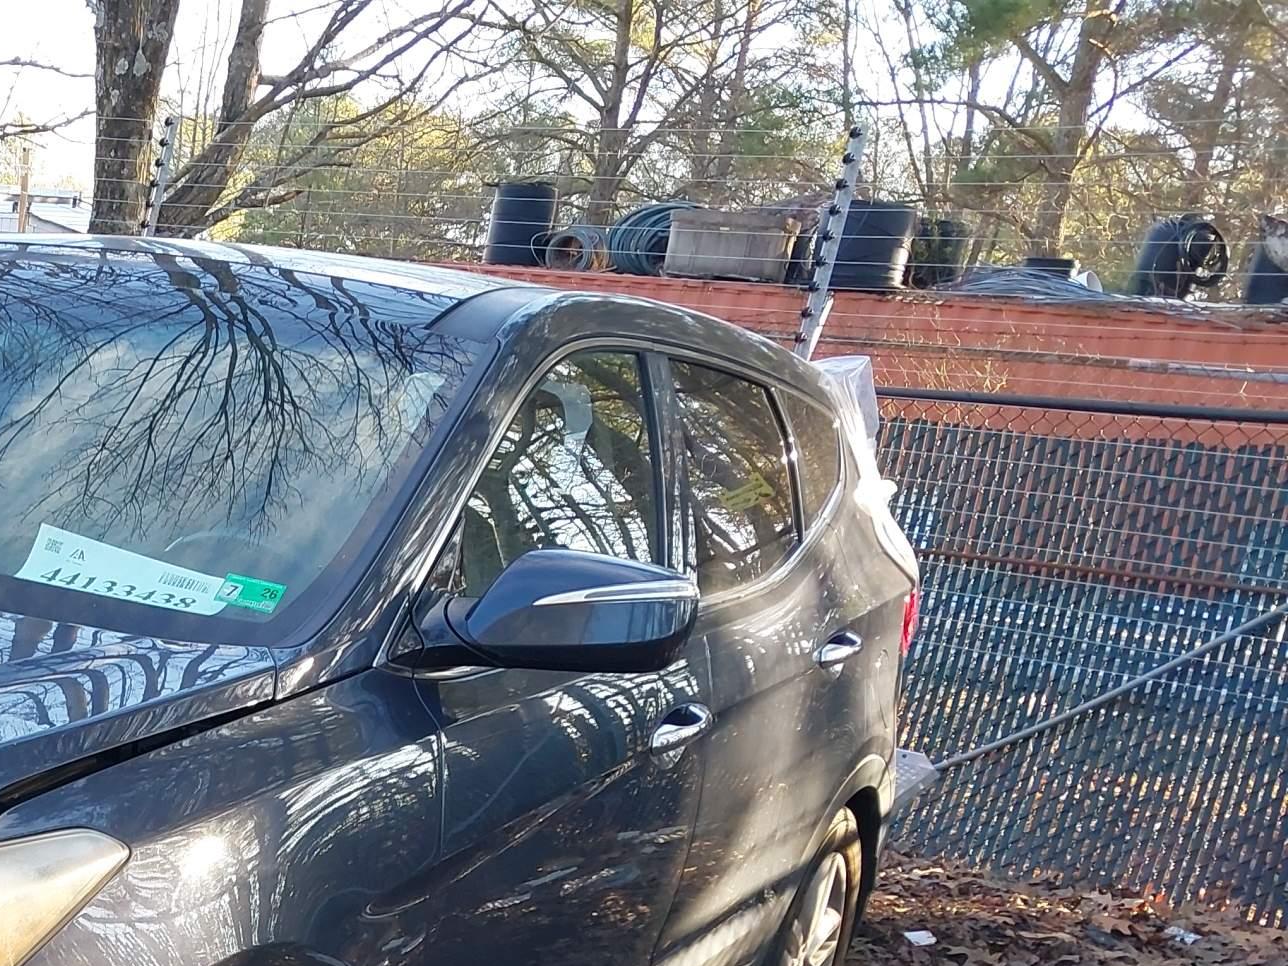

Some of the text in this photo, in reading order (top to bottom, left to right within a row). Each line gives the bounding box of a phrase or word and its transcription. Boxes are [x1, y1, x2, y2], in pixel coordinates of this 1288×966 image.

[39, 566, 198, 609] 44133438
[225, 584, 239, 597] 7
[259, 587, 280, 600] 26
